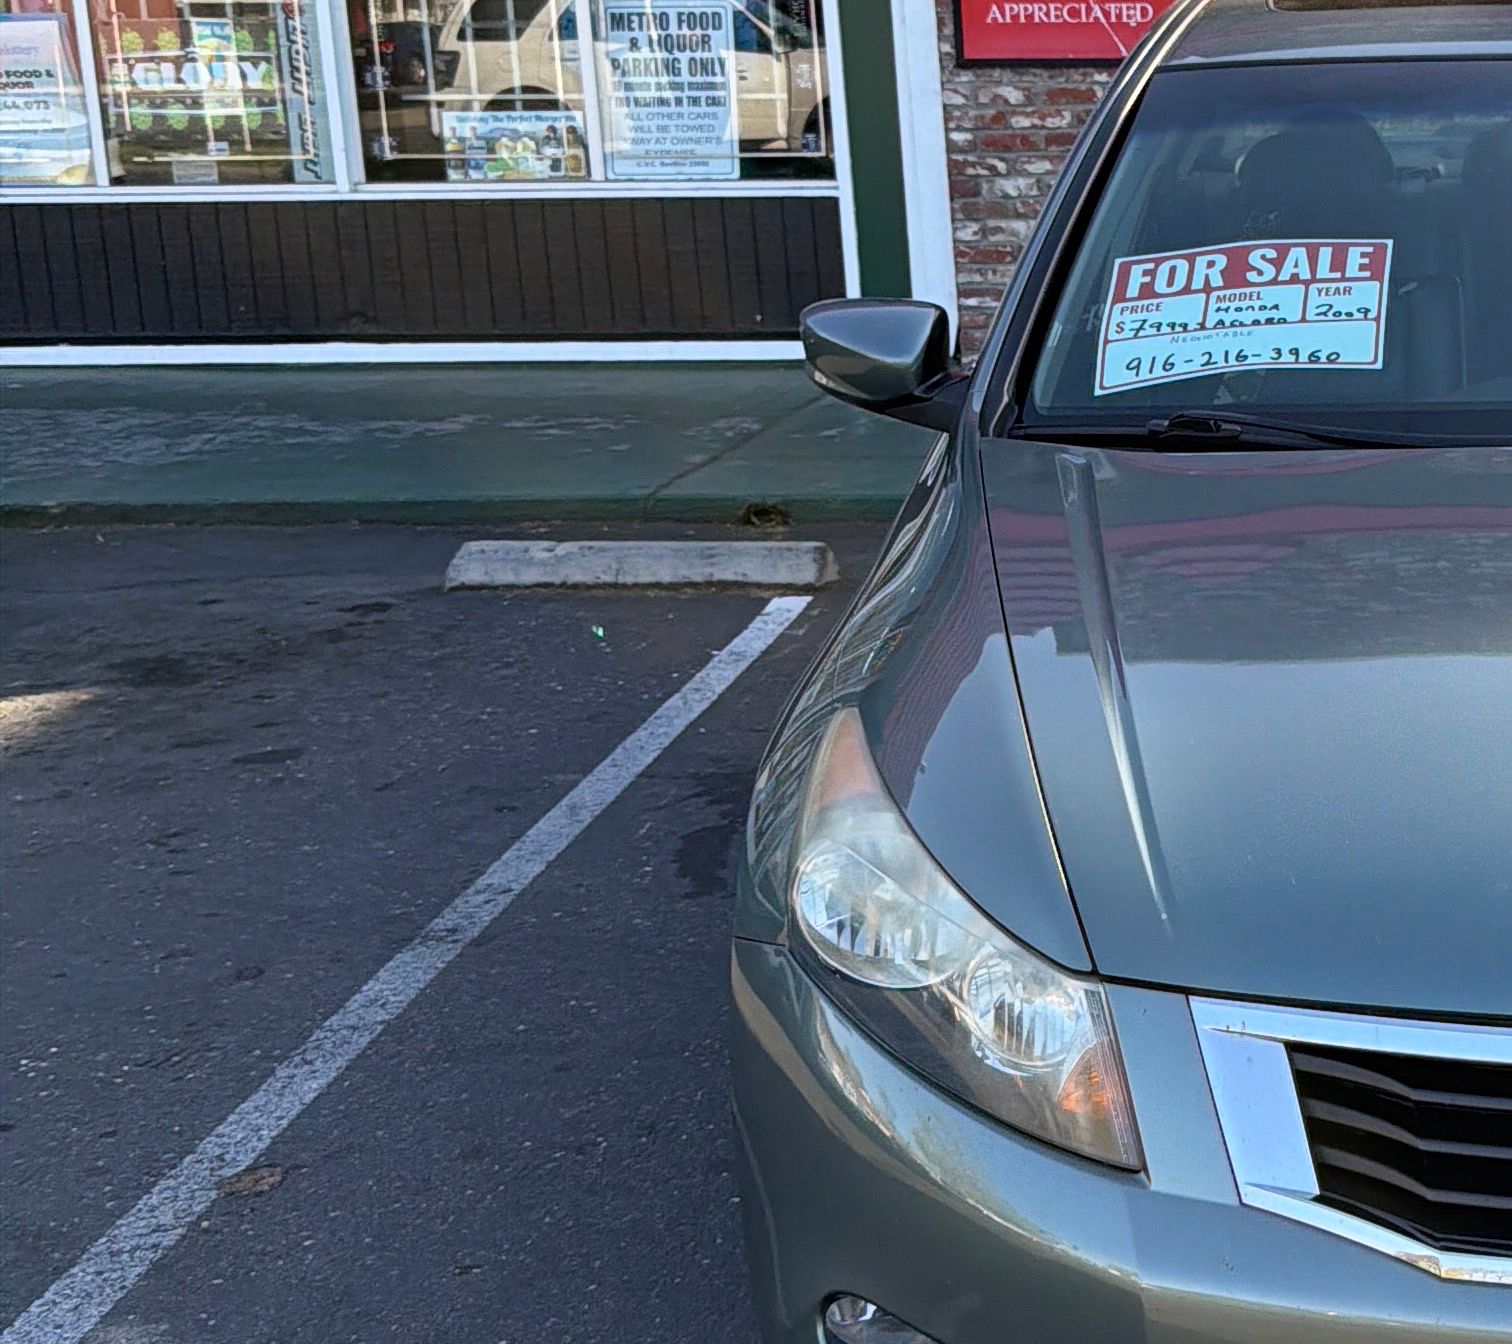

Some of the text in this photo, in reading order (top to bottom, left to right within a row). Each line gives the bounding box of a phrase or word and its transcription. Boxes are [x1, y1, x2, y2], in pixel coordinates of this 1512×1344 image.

[609, 11, 723, 32] METRO FOOD
[986, 2, 1154, 25] APPRECIATED
[628, 33, 712, 55] & LIQUOR
[610, 56, 727, 78] PARKING ONLY
[687, 96, 702, 107] THE
[646, 112, 686, 122] OTHER
[687, 112, 719, 121] CARS
[656, 124, 673, 134] BE
[675, 124, 716, 134] TOWED
[623, 137, 651, 146] WAY
[654, 136, 668, 146] AT
[1125, 246, 1375, 299] FOR SALE
[1214, 290, 1264, 306] MODEL
[1316, 285, 1354, 298] YEAR
[1119, 301, 1164, 317] PRICE
[1314, 303, 1373, 319] 2009
[1125, 347, 1341, 378] 916-216-3960
